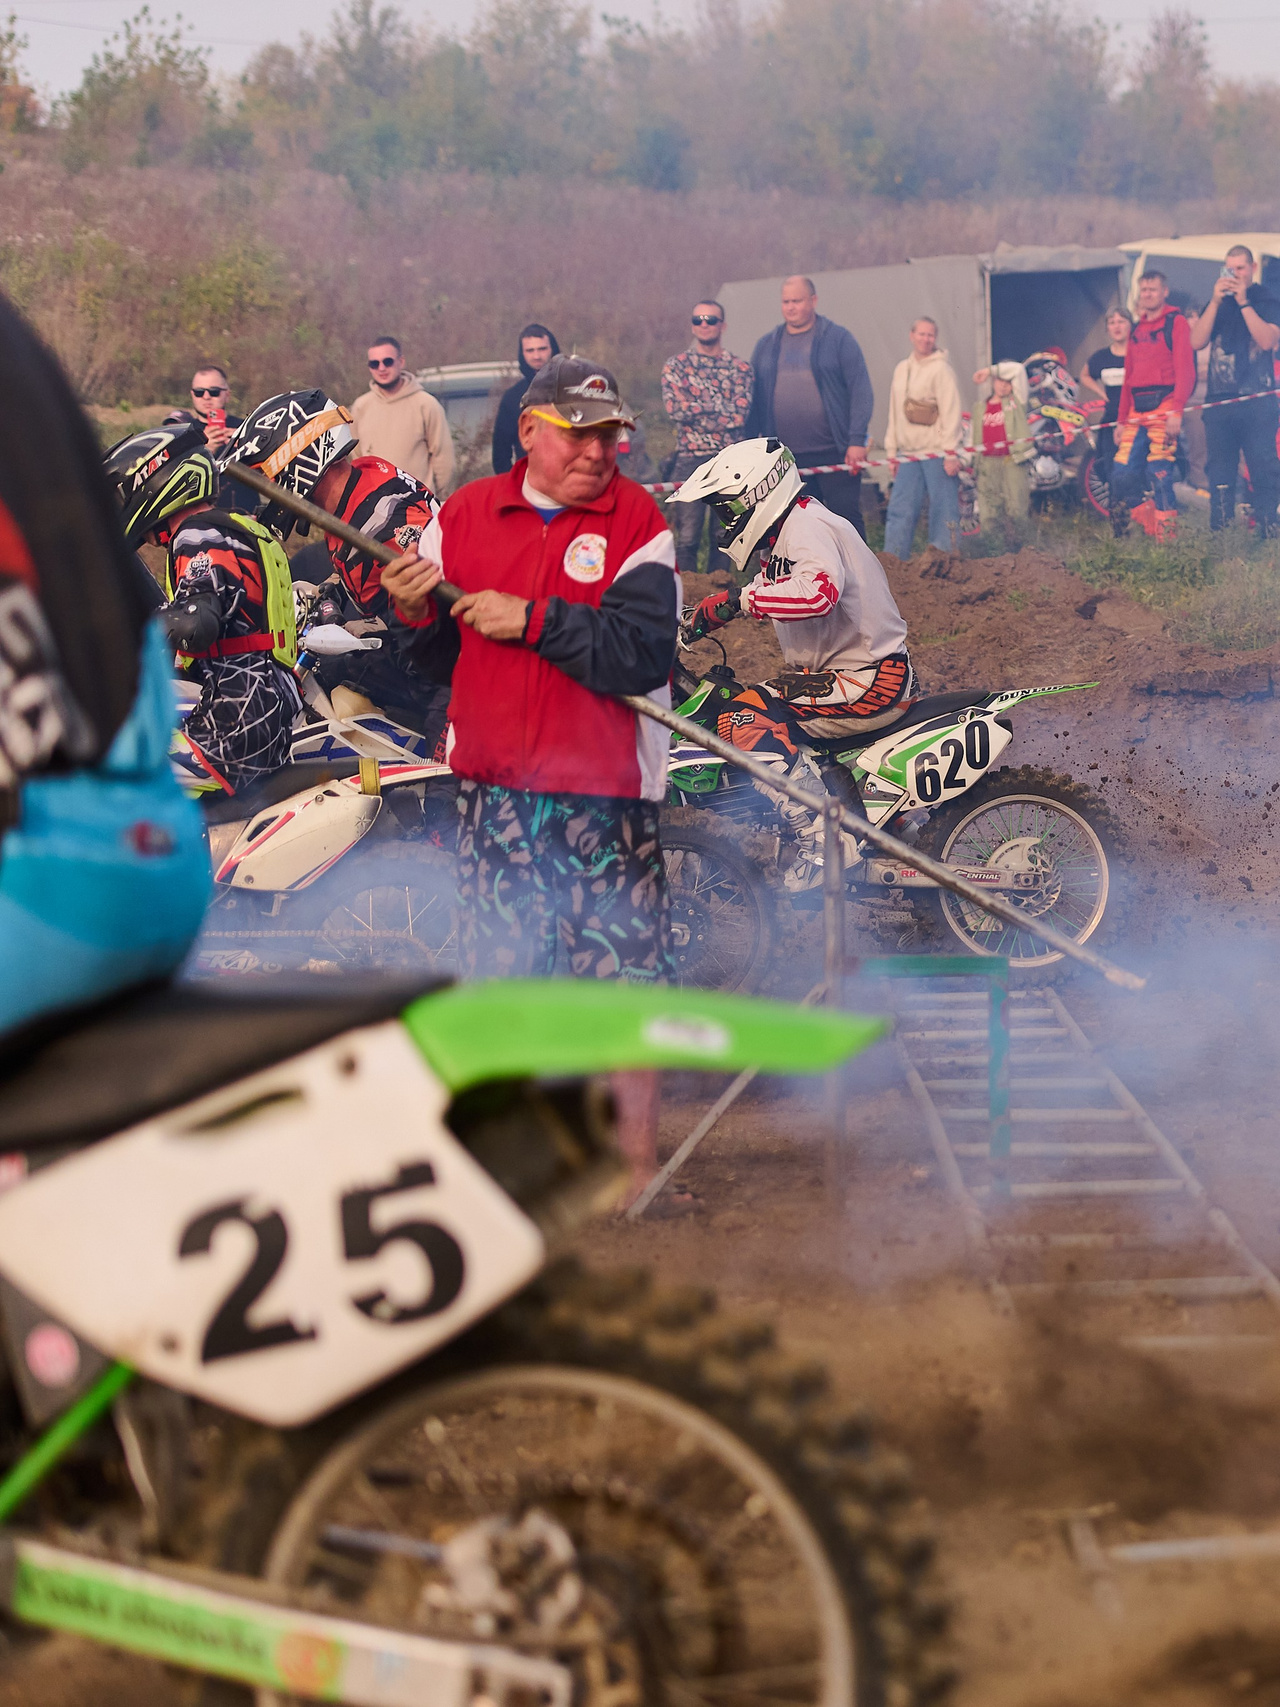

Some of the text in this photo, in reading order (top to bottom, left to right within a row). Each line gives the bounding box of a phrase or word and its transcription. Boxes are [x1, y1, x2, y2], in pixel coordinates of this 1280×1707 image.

[132, 448, 171, 492] ATAKI
[267, 417, 326, 477] 100%
[743, 455, 790, 509] 100%
[914, 720, 990, 802] 620
[901, 870, 917, 878] RK
[179, 1162, 465, 1363] 25
